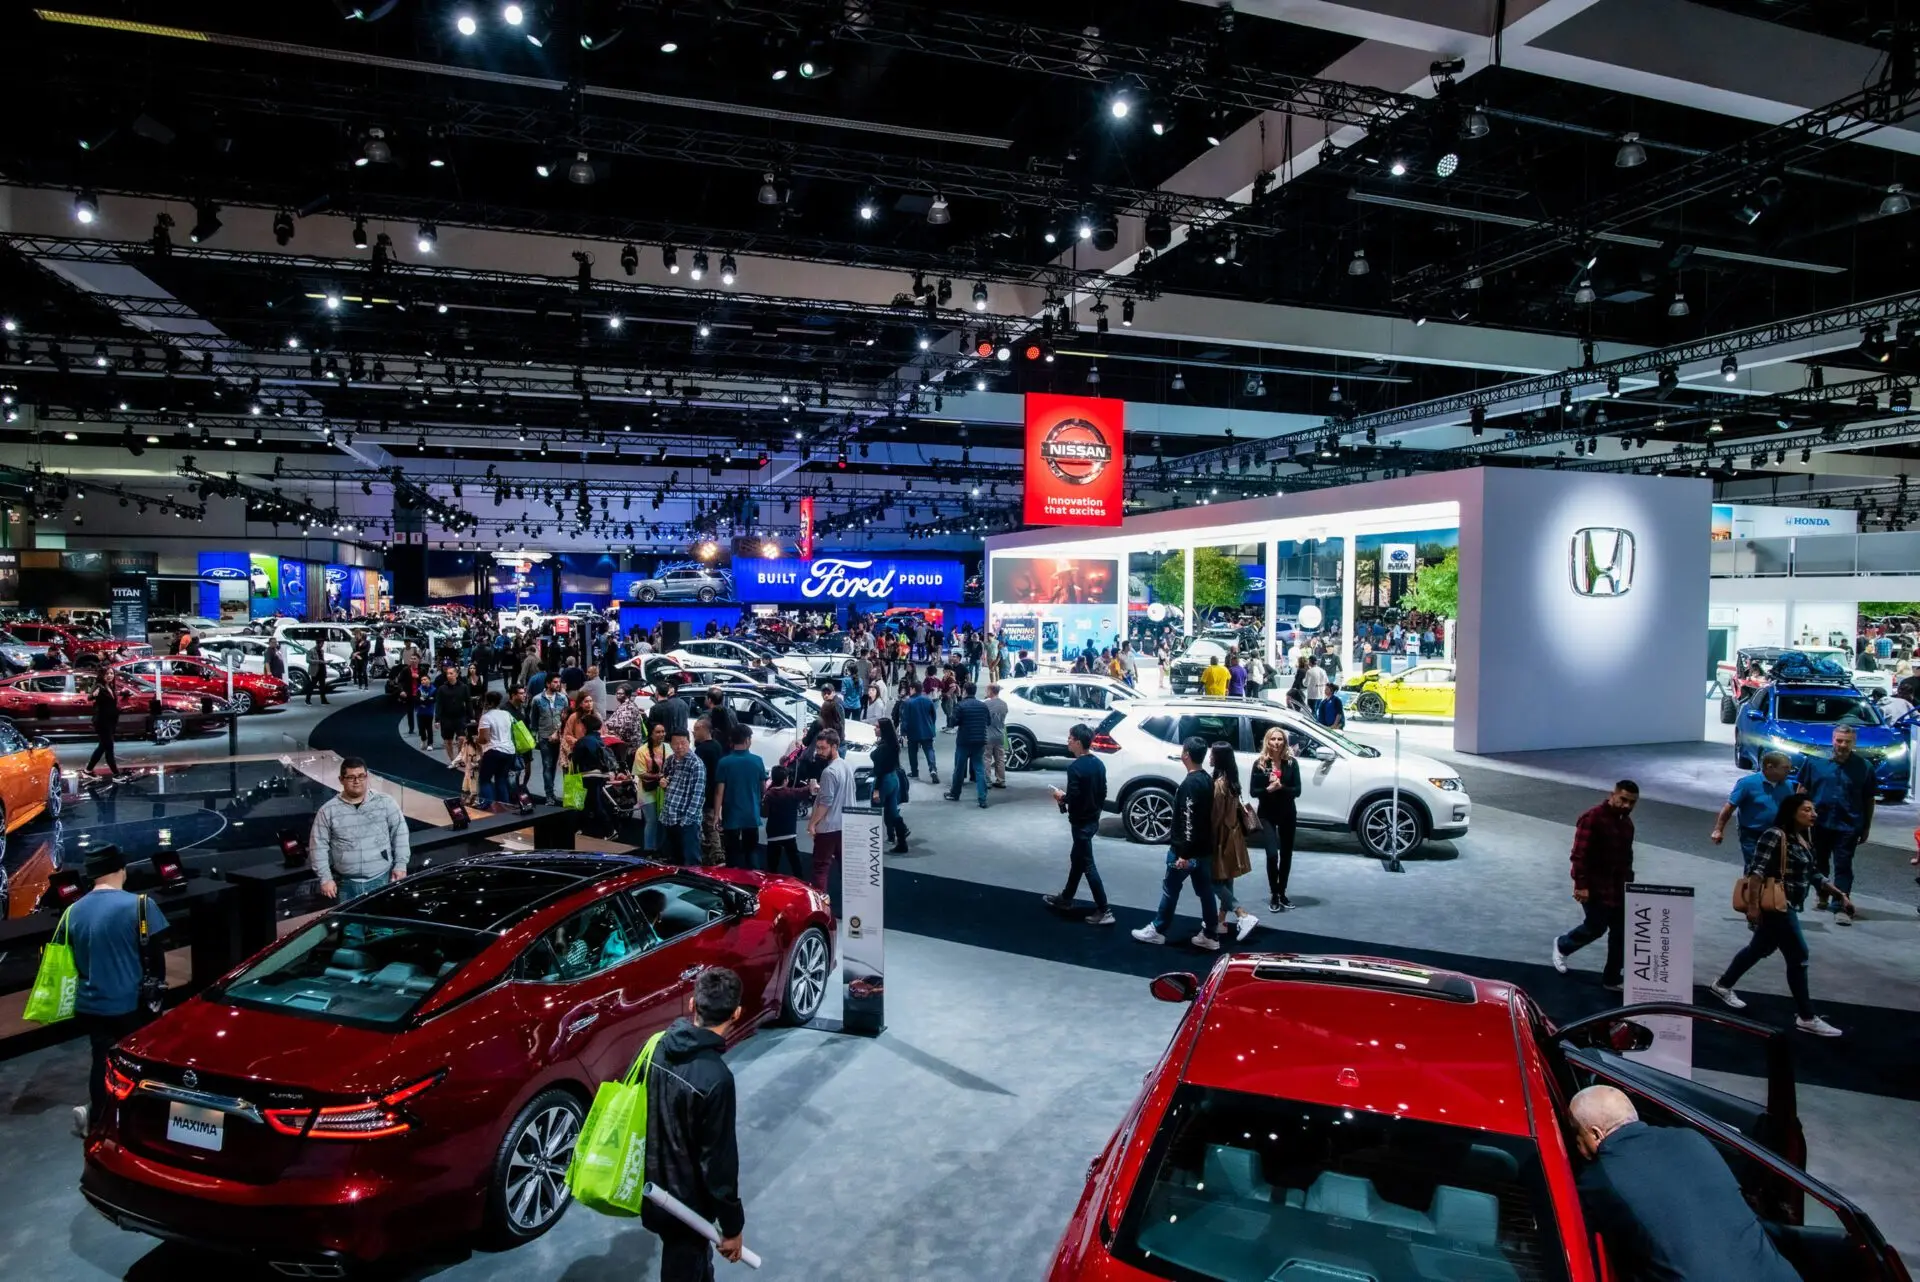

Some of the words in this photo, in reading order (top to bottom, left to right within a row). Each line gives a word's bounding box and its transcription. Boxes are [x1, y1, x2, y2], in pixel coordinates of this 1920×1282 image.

[1050, 445, 1105, 458] NISSAN
[1044, 505, 1067, 515] that
[1069, 507, 1106, 516] excites
[1047, 496, 1103, 507] Innovation
[1793, 517, 1831, 527] HONDA
[757, 572, 797, 584] BUILT
[801, 558, 896, 598] Ford
[899, 574, 943, 585] PROUD
[112, 588, 140, 597] TITAN
[868, 825, 881, 887] MAXIMA
[1660, 908, 1670, 935] Drive
[1633, 907, 1651, 982] ALTIMA
[1659, 937, 1670, 984] All-Wheel
[172, 1115, 218, 1137] MAXIMA
